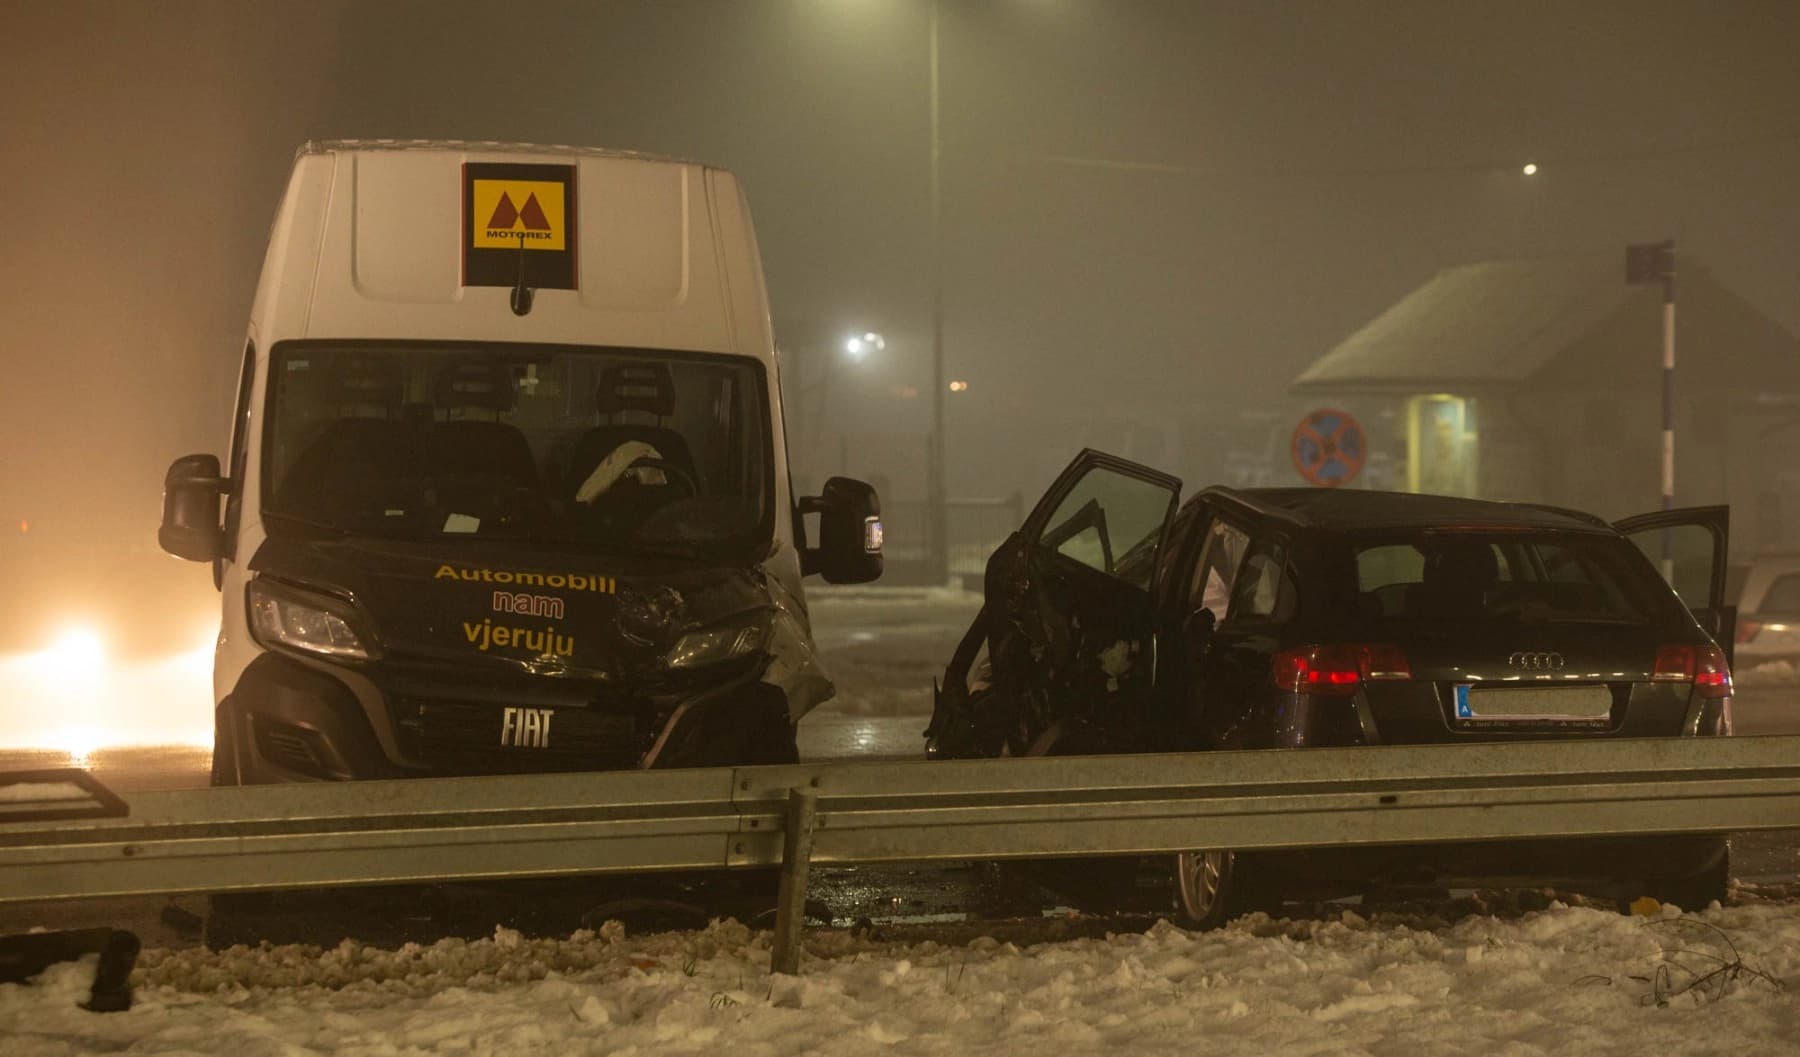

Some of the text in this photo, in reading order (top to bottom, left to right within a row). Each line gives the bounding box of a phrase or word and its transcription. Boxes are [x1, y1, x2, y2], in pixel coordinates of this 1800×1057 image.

[486, 231, 552, 240] MOTOREX
[493, 590, 564, 620] nam
[463, 618, 574, 657] vjeruju
[501, 707, 554, 748] FIAT
